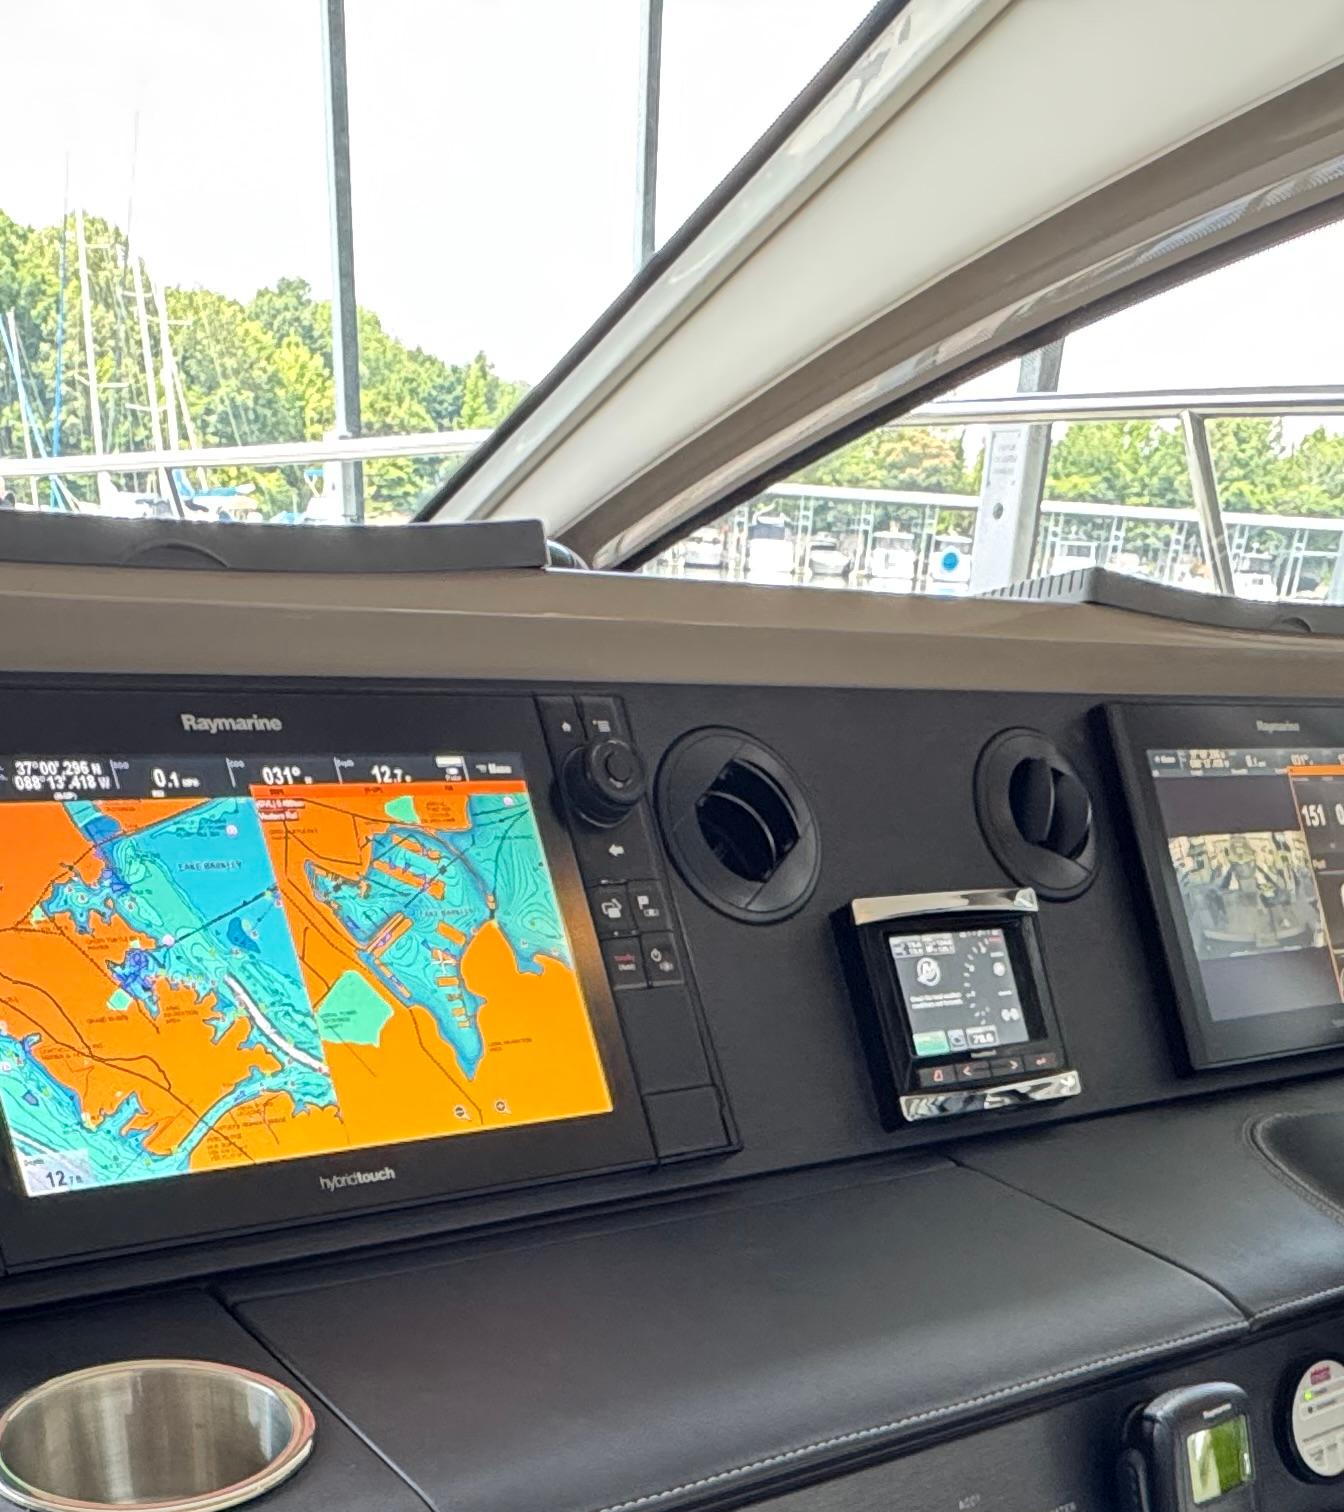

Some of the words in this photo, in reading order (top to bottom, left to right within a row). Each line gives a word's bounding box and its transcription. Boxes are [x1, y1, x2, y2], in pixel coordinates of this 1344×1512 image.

[180, 713, 283, 734] Raymarine
[152, 768, 180, 789] 0.1
[262, 766, 301, 786] 031°
[1301, 803, 1326, 828] 151
[319, 1166, 396, 1190] hybridtouch
